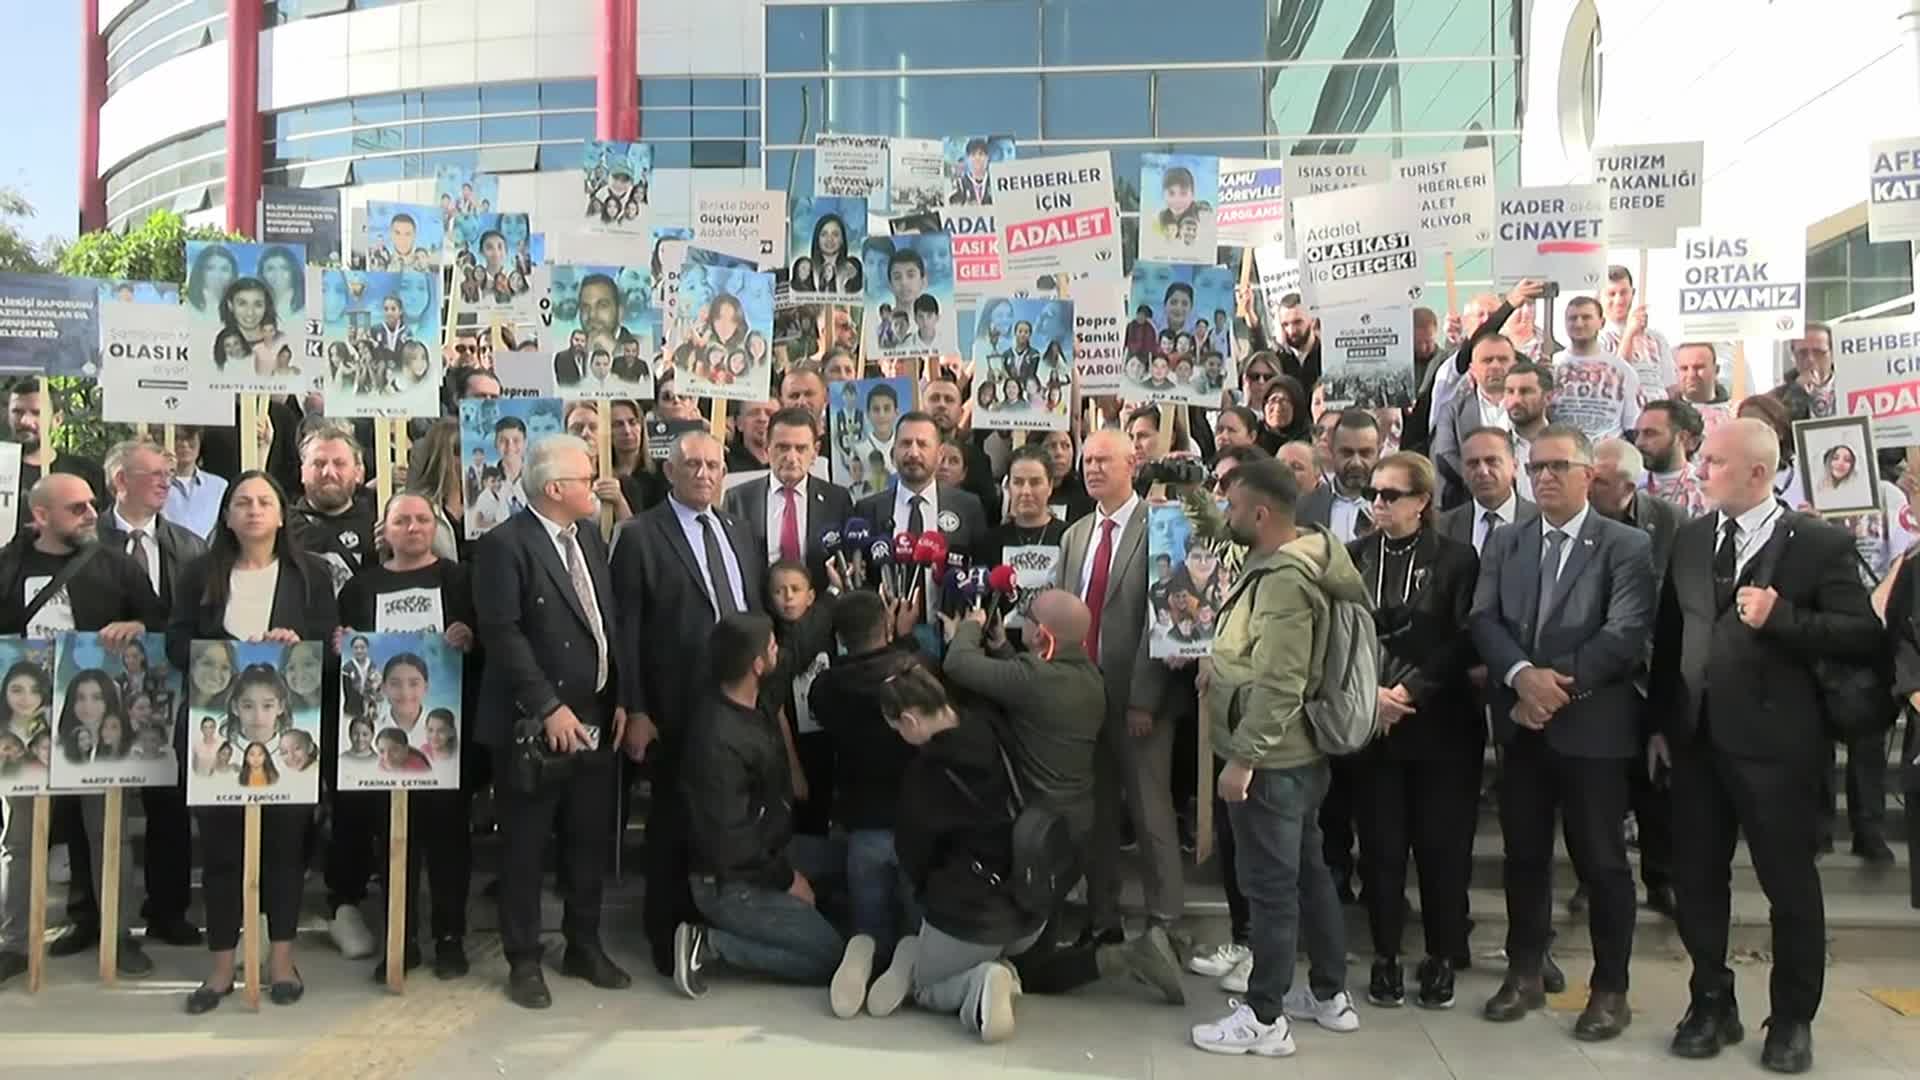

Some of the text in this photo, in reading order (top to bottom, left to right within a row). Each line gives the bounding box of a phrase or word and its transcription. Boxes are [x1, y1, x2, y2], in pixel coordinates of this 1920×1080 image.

[1335, 165, 1367, 177] OTEL
[1400, 162, 1447, 178] TURİST
[1597, 154, 1665, 171] TURİZM
[997, 168, 1101, 191] REHBERLER
[1597, 170, 1696, 190] AKANLIĞI
[1036, 192, 1072, 212] İÇİN
[1501, 199, 1564, 215] KADER
[1009, 212, 1105, 250] ADALET
[1307, 221, 1360, 243] Adalet
[1500, 219, 1602, 241] CİNAYET
[1307, 233, 1411, 263] OLASI KAST
[1333, 252, 1416, 280] GELECEK!
[1685, 262, 1768, 285] ORTAK
[1683, 285, 1798, 311] DAVAMIZ
[109, 343, 171, 360] OLASI
